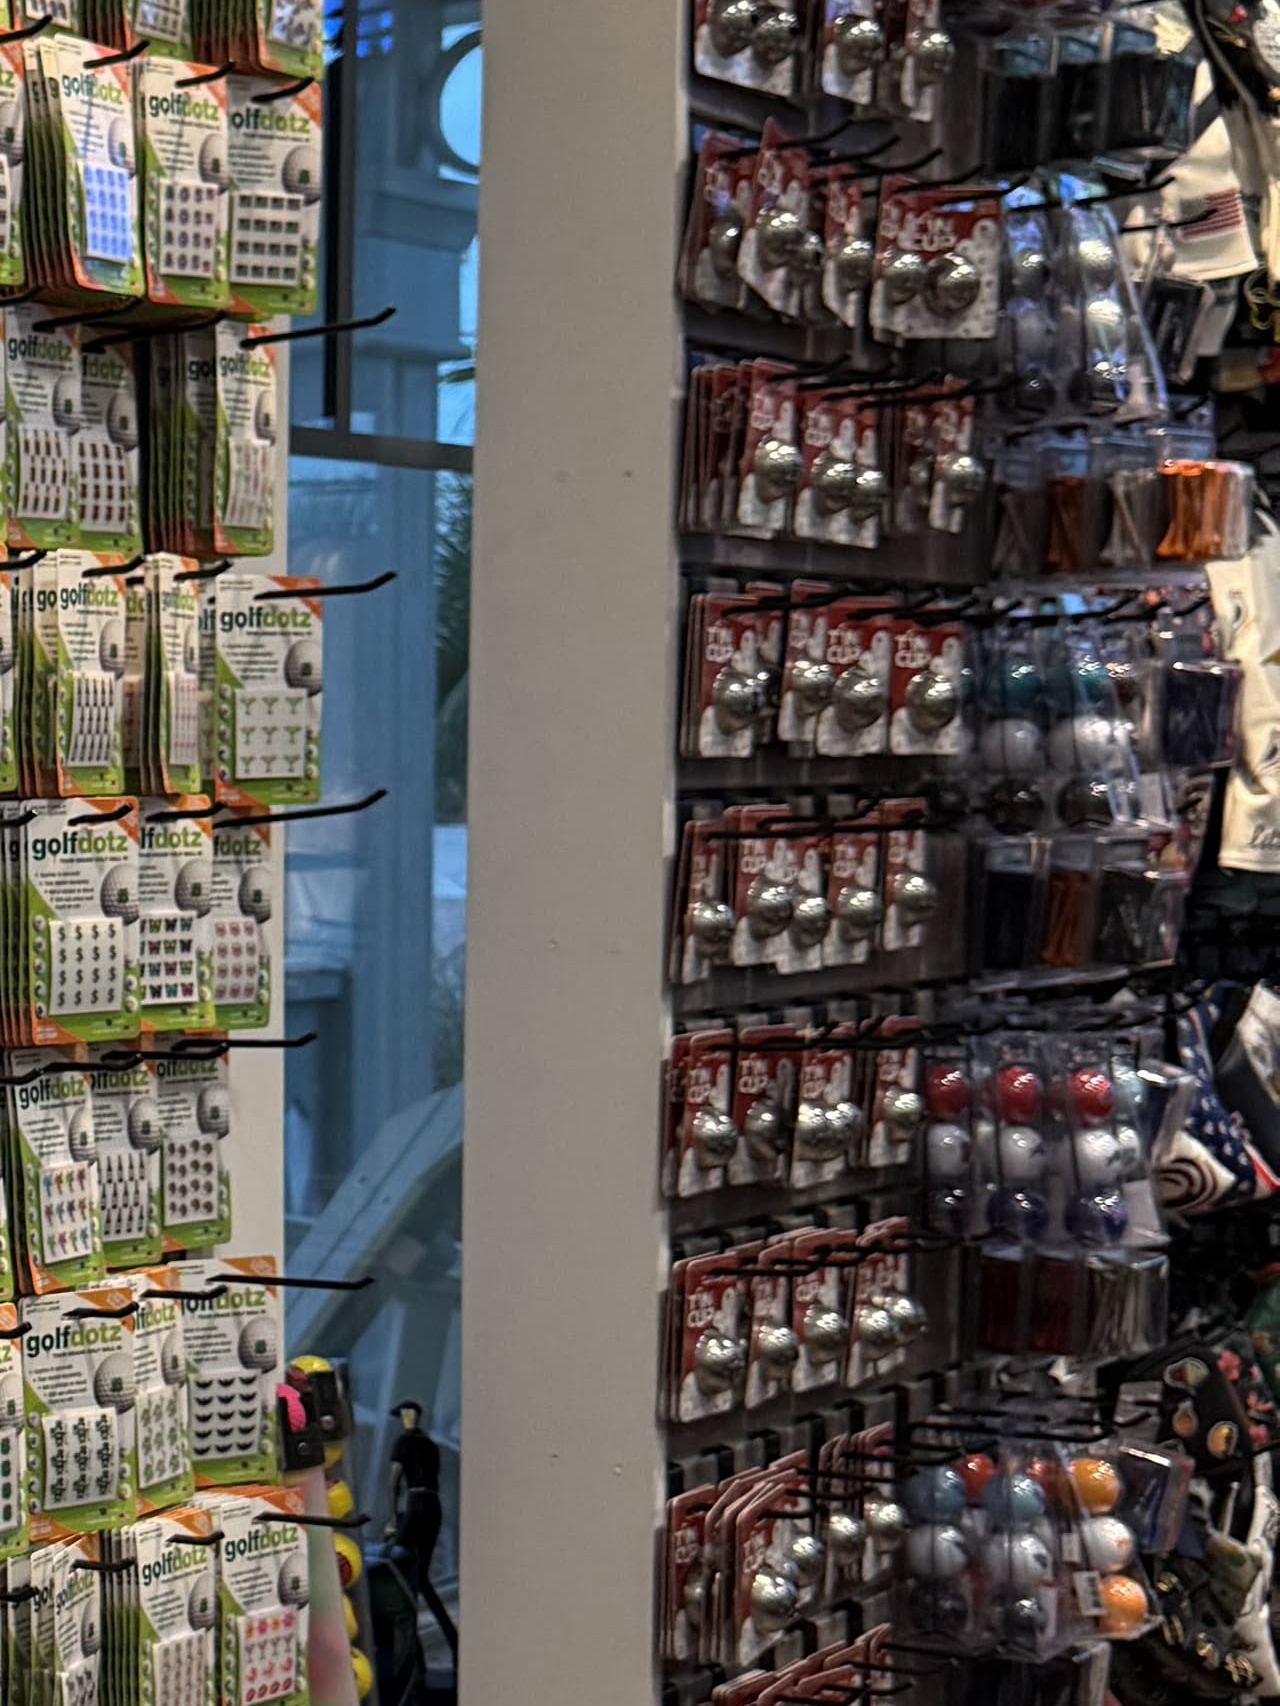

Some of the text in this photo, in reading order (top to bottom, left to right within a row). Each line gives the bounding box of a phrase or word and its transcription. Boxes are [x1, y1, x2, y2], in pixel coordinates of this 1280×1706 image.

[63, 73, 122, 103] golfdotz
[149, 93, 219, 122] golfdotz
[8, 337, 73, 362] golfdotz
[220, 353, 271, 376] golfdotz
[61, 584, 119, 609] golfdotz
[221, 607, 311, 630] golfdotz
[33, 827, 127, 859] golfdotz
[19, 1077, 85, 1109] golfdotz
[27, 1324, 121, 1356] golfdotz
[226, 1526, 298, 1560] golfdotz
[142, 1546, 207, 1584] golfdotz
